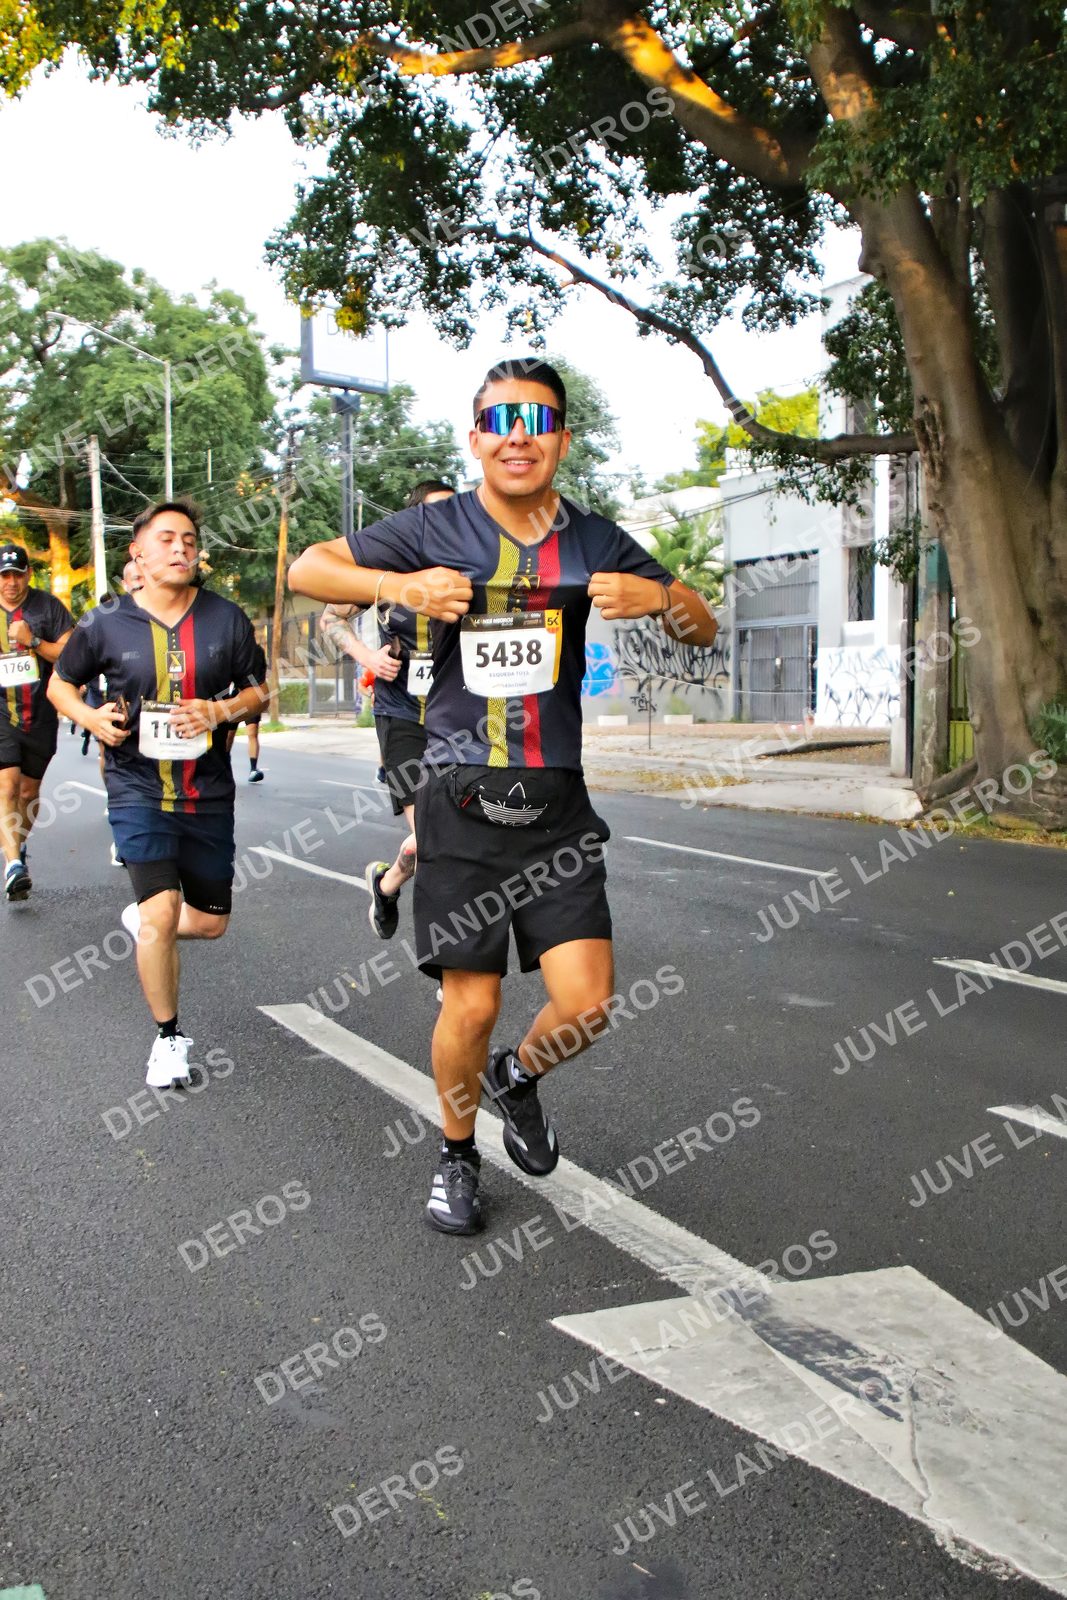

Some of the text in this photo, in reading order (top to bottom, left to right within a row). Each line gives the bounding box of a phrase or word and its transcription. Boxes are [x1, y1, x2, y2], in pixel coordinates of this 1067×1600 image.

[547, 617, 559, 626] 5K
[476, 639, 542, 668] 5438
[3, 660, 31, 674] 1766
